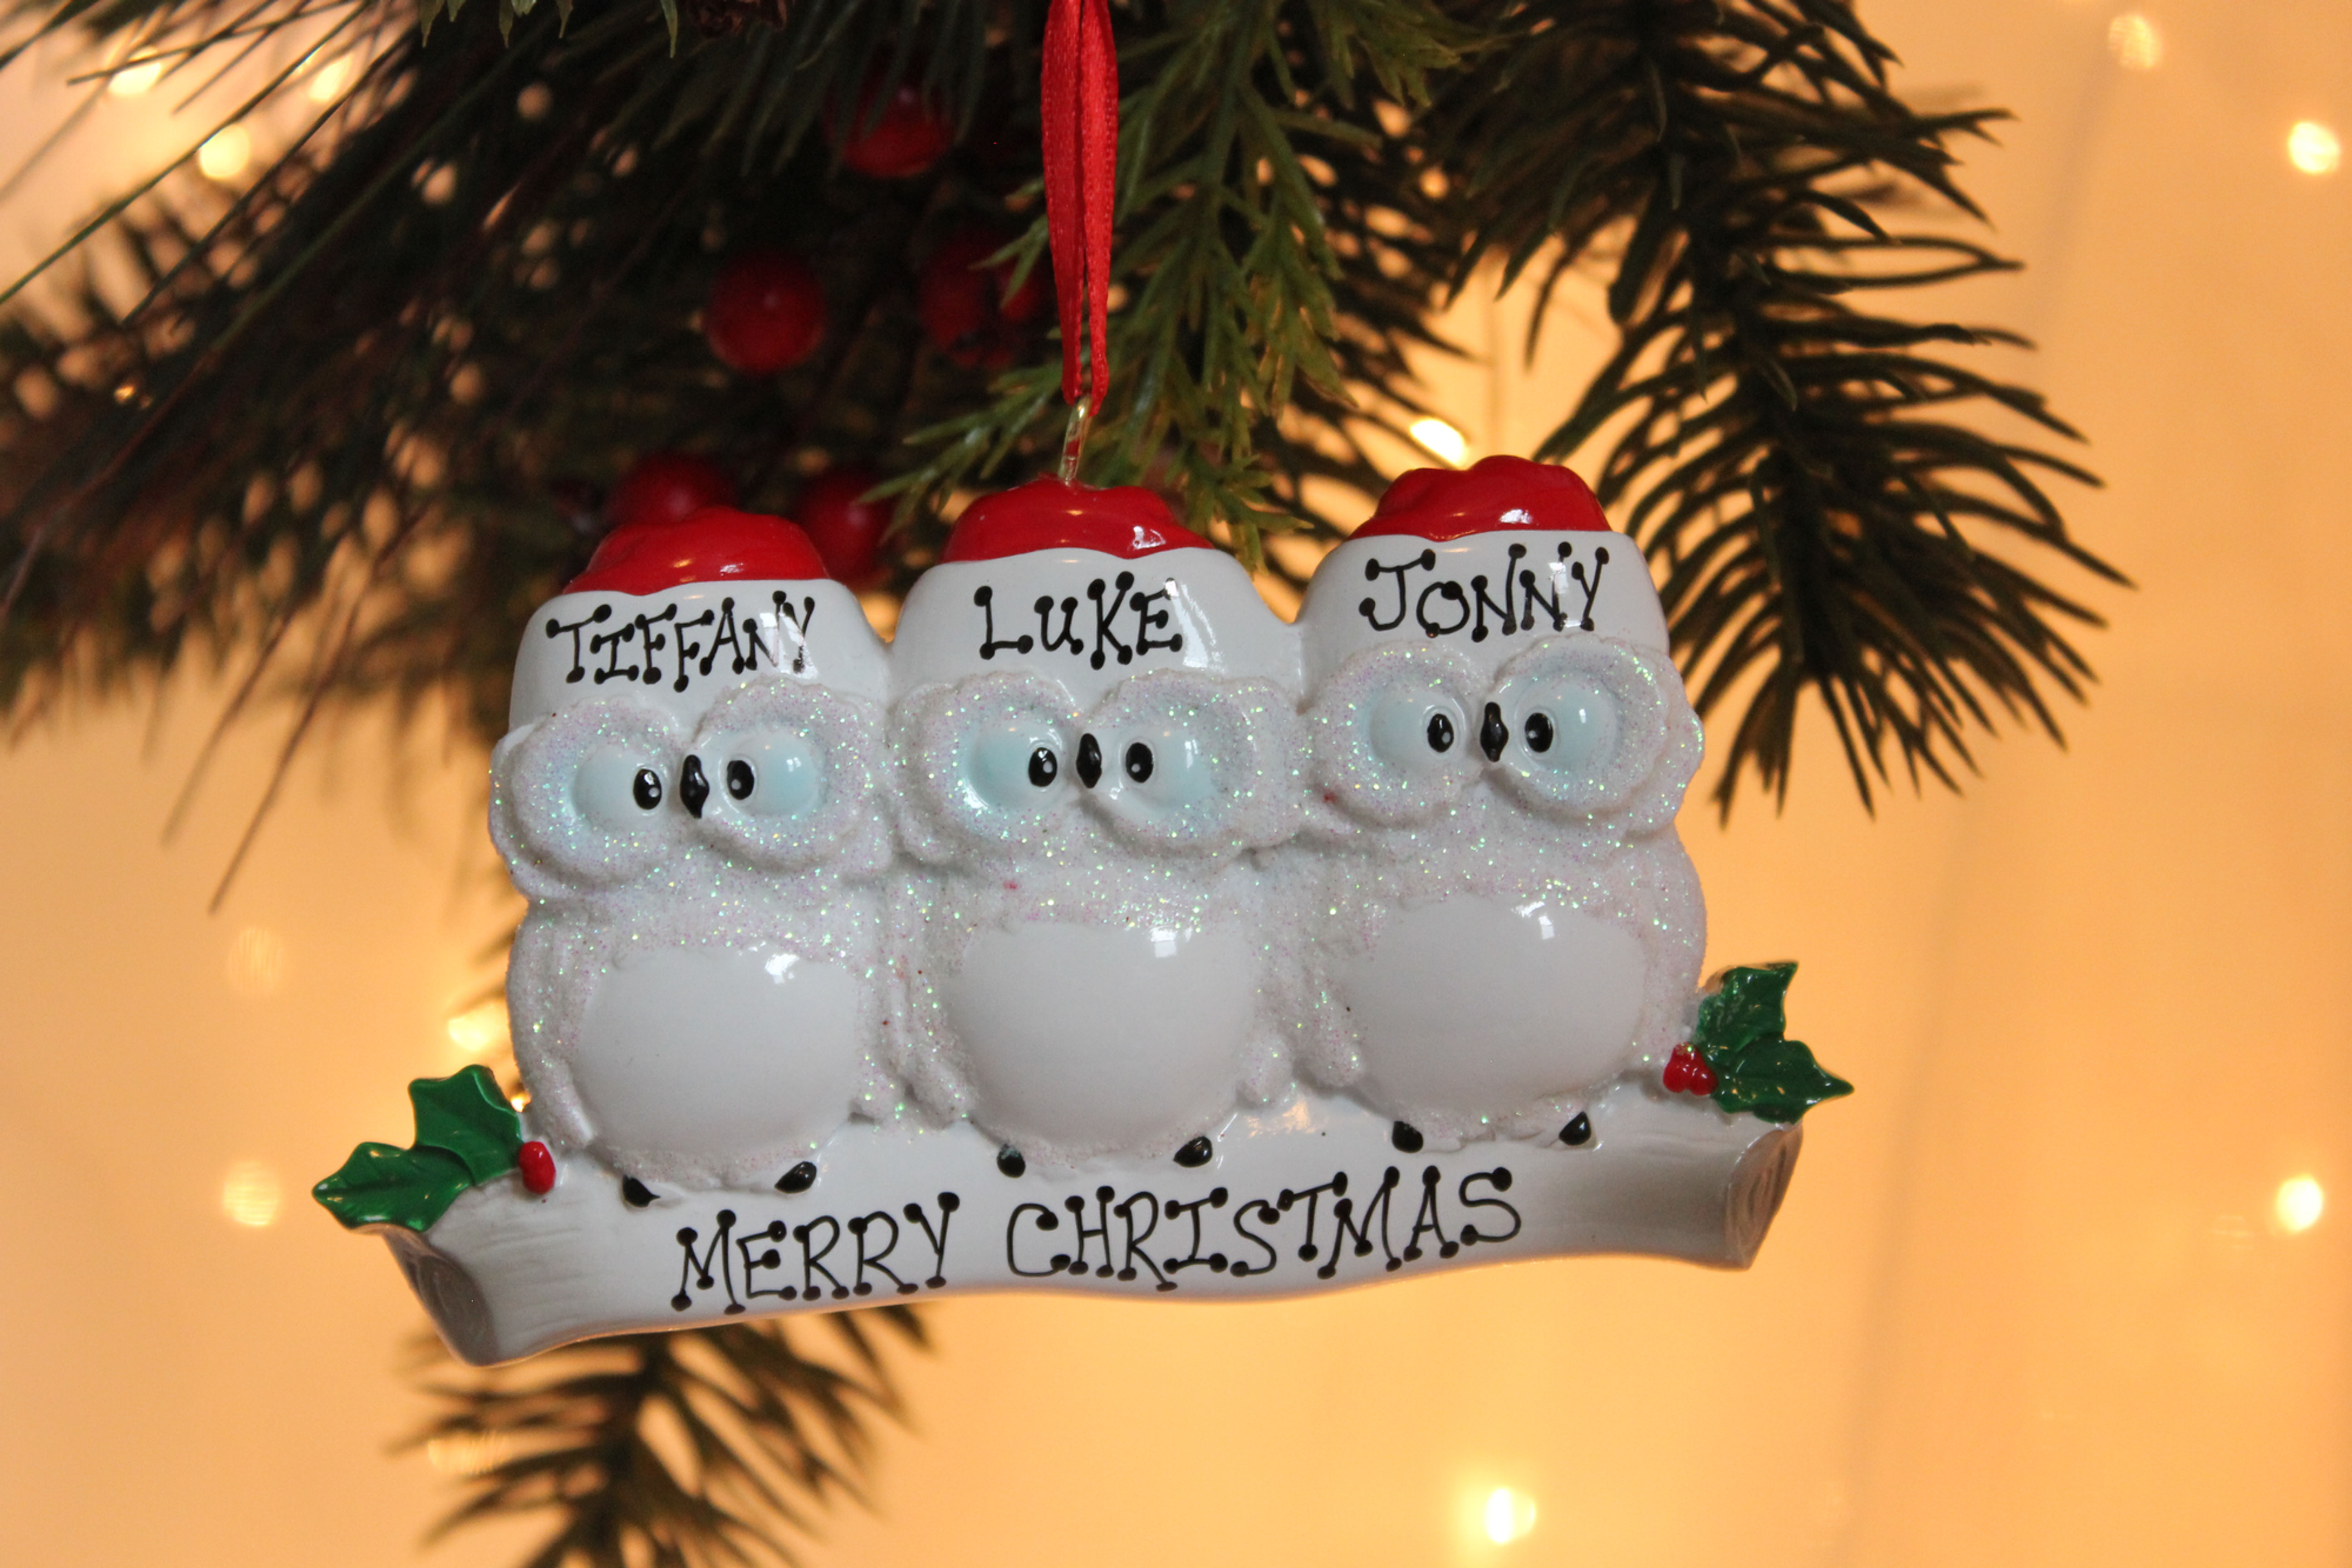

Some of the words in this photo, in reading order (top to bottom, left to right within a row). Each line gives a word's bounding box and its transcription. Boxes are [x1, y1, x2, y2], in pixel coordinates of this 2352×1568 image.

[546, 590, 815, 692] TIFFANY
[974, 571, 1182, 670] LUKE
[1359, 542, 1610, 642] JONNY
[671, 1191, 960, 1315] MERRY
[1006, 1166, 1521, 1292] CHRISTMAS
